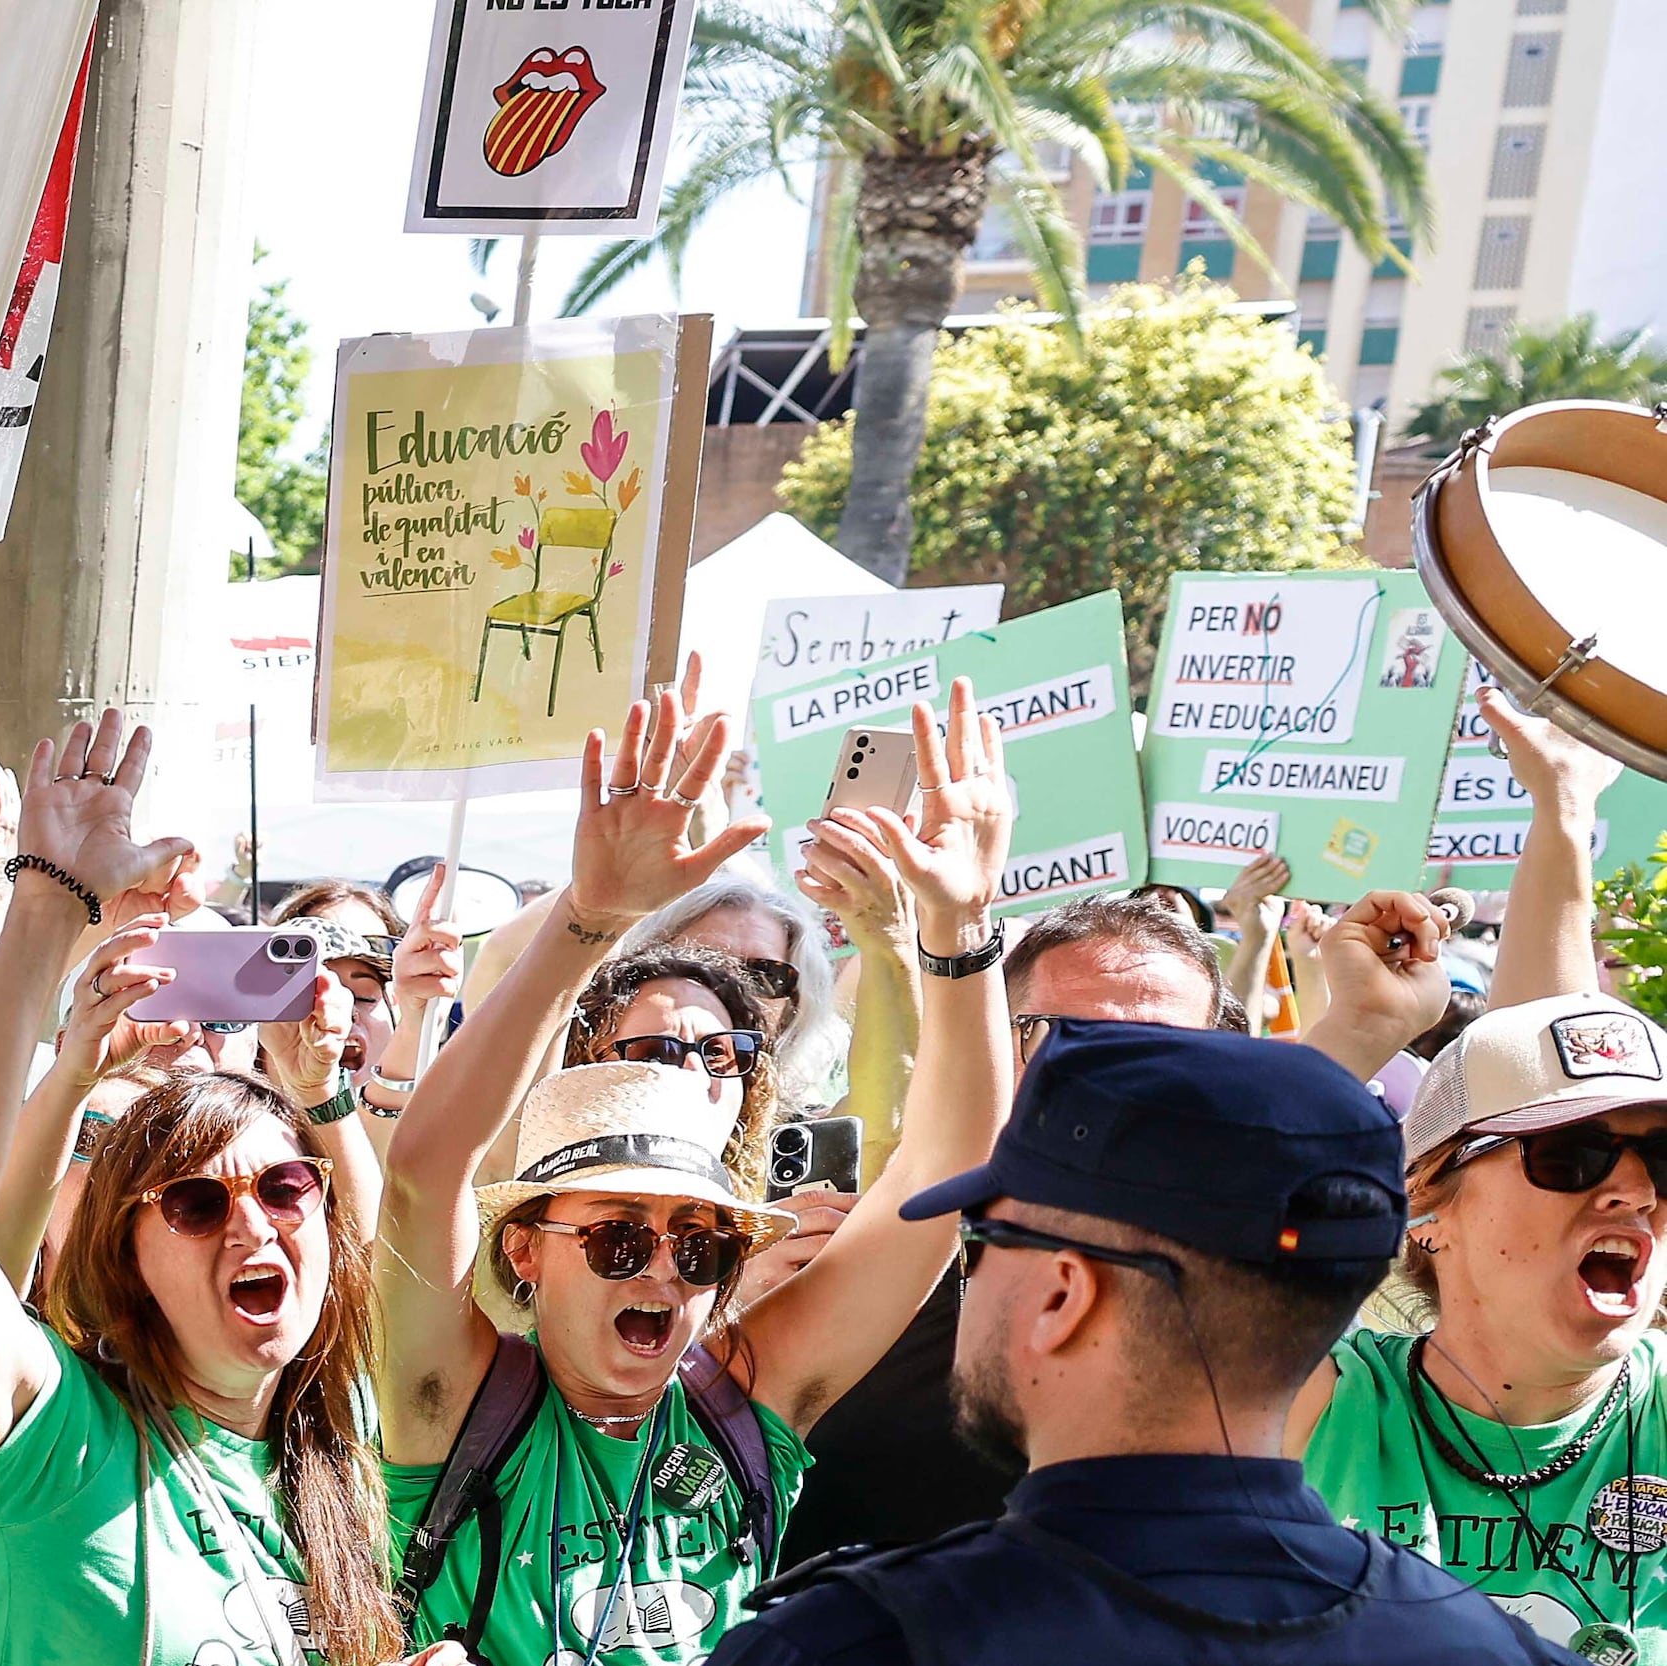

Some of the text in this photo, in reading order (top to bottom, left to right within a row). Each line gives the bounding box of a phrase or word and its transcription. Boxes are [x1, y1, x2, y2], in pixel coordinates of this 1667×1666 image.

[367, 410, 571, 474] Educació
[364, 496, 515, 558] de qualitat
[376, 546, 445, 566] i en
[360, 557, 476, 591] valencià
[1189, 604, 1282, 635] PER NO
[1179, 654, 1295, 682] INVERTIR
[789, 666, 931, 728] LA PROFE
[1169, 700, 1338, 733] EN EDUCACIÓ
[489, 736, 523, 747] VAGA
[1217, 762, 1388, 791] ENS DEMANEU
[1454, 772, 1494, 801] ÉS
[1166, 817, 1269, 849] VOCACIÓ
[1000, 848, 1114, 896] UCANT
[572, 1143, 601, 1159] REAL
[653, 1443, 689, 1489] DOCENT
[675, 1458, 713, 1497] VAGA
[676, 1464, 688, 1477] EN
[689, 1464, 723, 1507] INDEFINIDA
[1611, 1513, 1661, 1536] PÚLICA
[1377, 1502, 1638, 1591] ETIMEM
